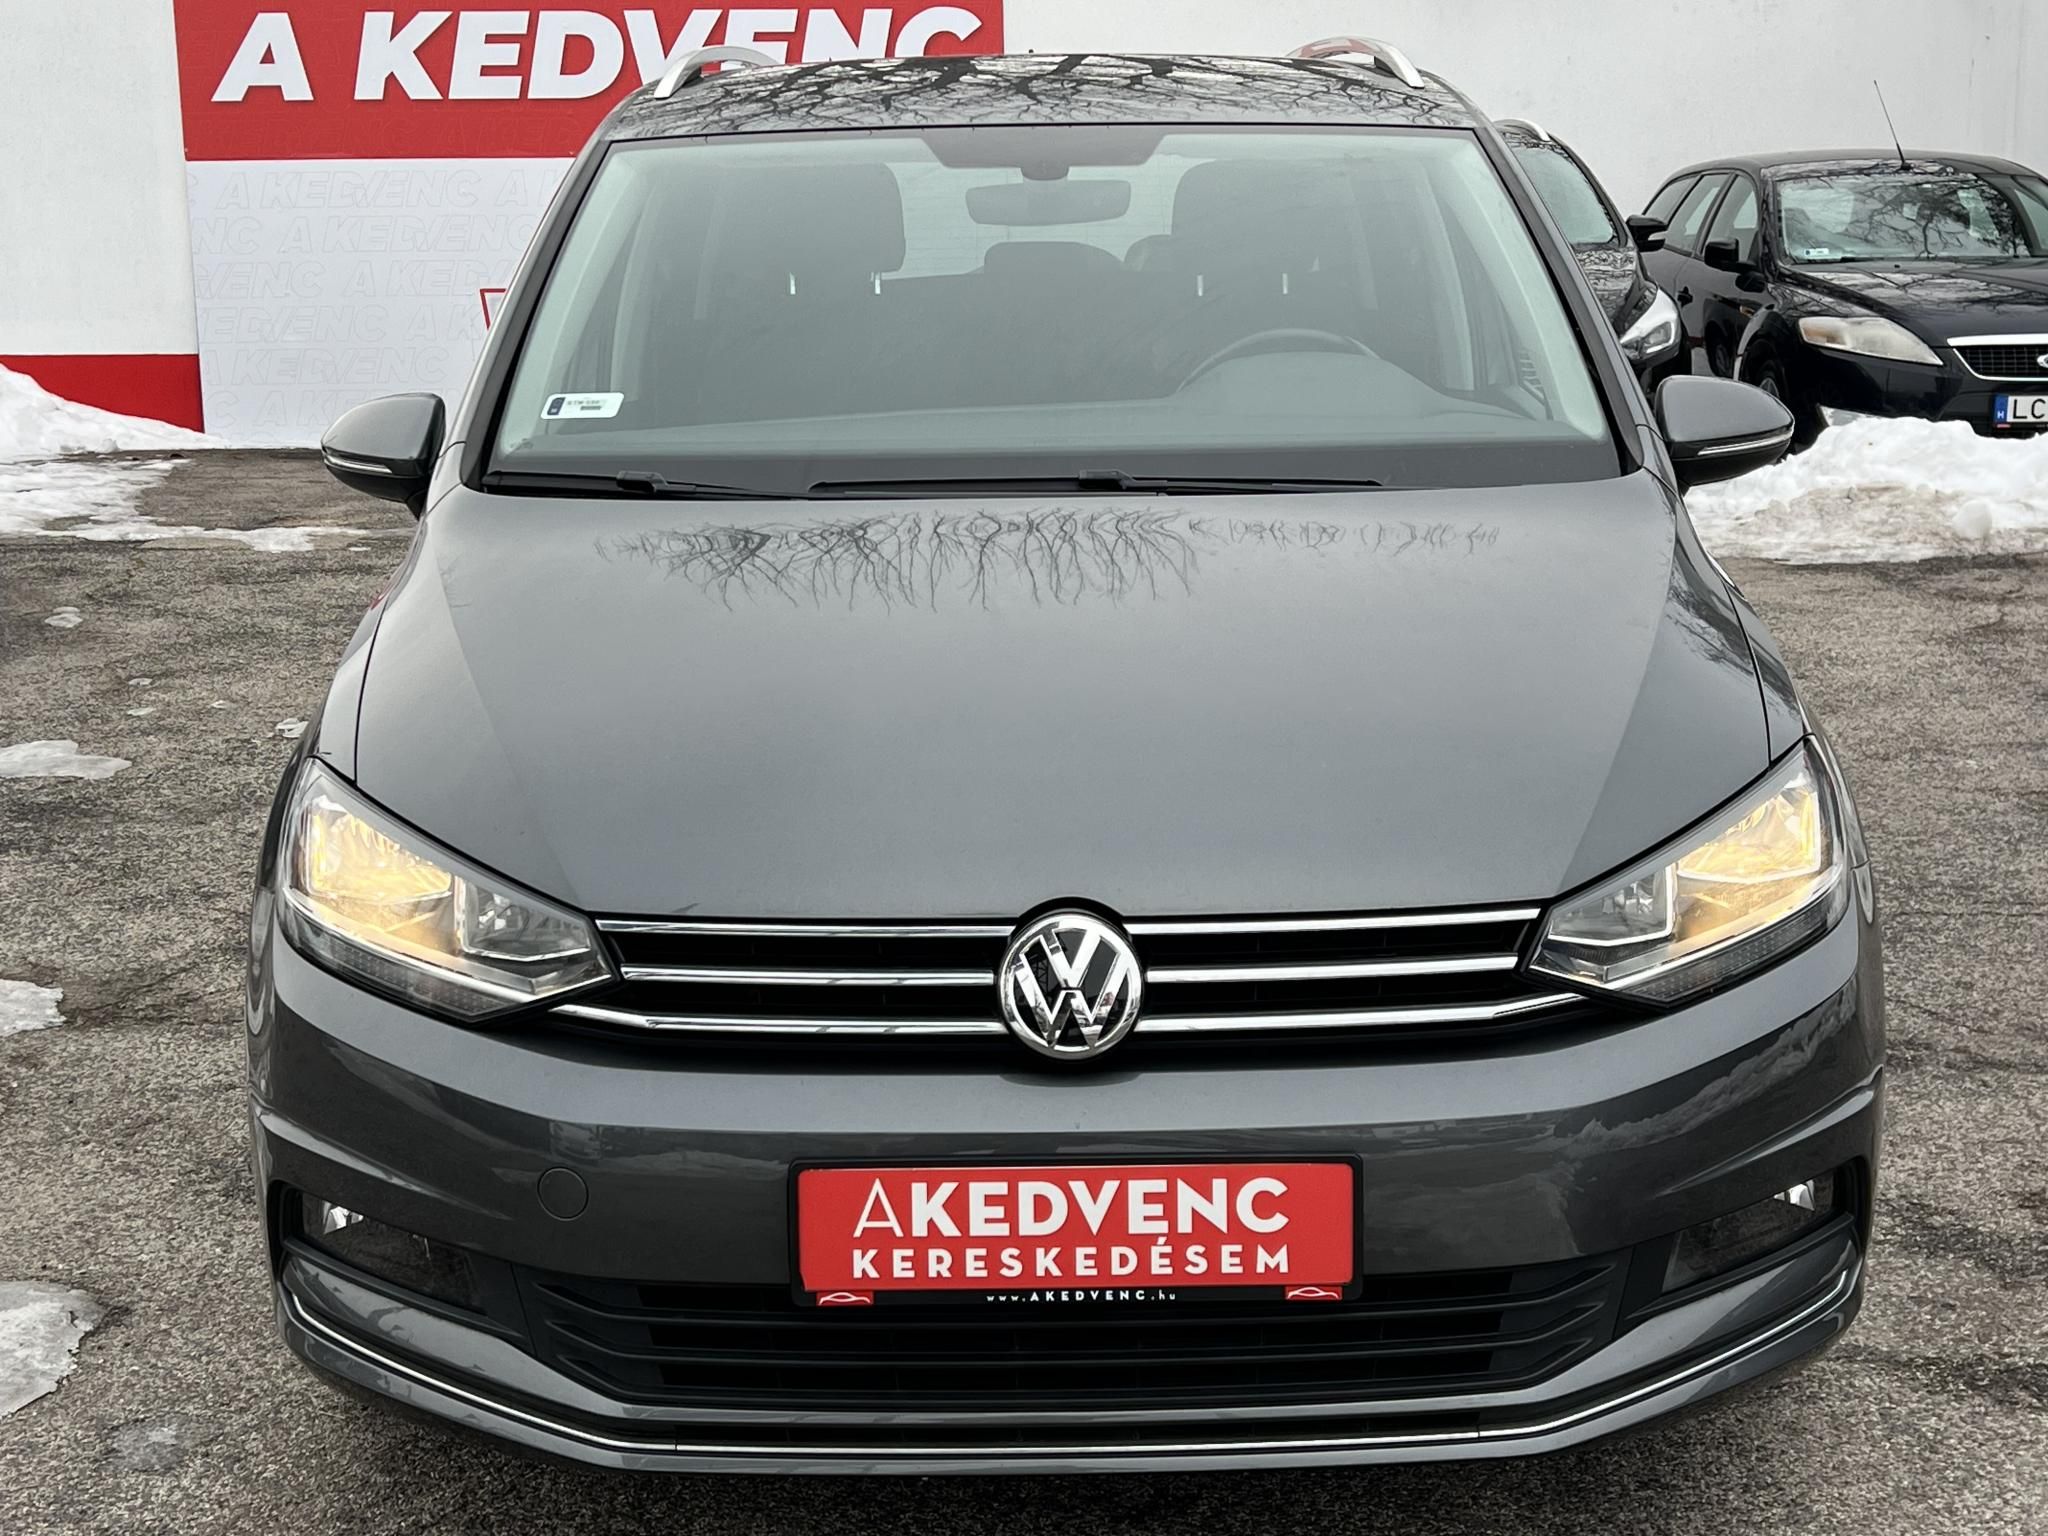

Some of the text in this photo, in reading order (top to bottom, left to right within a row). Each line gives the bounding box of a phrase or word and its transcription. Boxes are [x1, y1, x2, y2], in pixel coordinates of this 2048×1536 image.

[210, 11, 315, 102] A
[200, 304, 389, 344] EDVENC
[852, 1237, 1289, 1280] KERESKEDÉSEM
[986, 1289, 1176, 1301] www.AKEDVENC.hu
